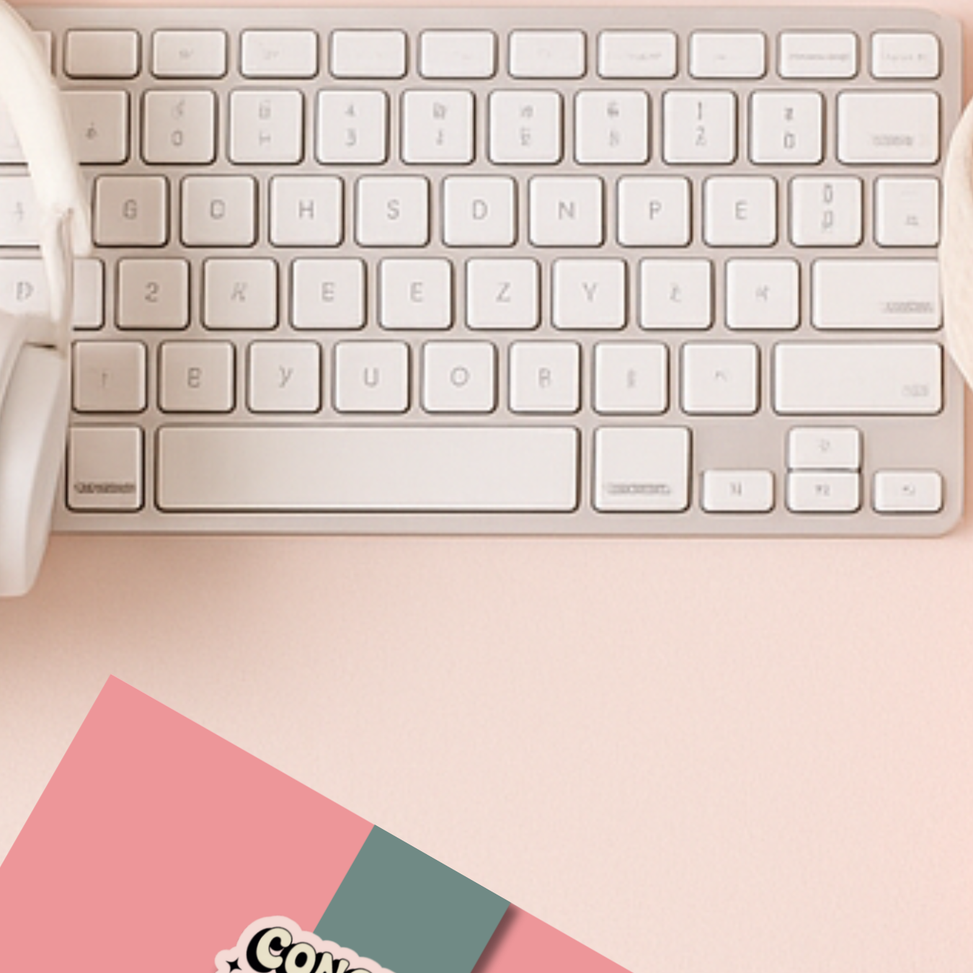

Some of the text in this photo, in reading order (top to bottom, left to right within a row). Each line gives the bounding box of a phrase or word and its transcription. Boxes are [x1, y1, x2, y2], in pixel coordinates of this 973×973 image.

[122, 198, 138, 220] G
[298, 199, 315, 220] H
[386, 198, 400, 221] S
[472, 199, 488, 220] D
[558, 201, 575, 220] N
[648, 200, 662, 221] P
[734, 199, 747, 221] E
[321, 281, 335, 303] E
[409, 281, 424, 303] E
[495, 281, 511, 303] Z
[582, 282, 597, 302] Y
[363, 367, 380, 388] U
